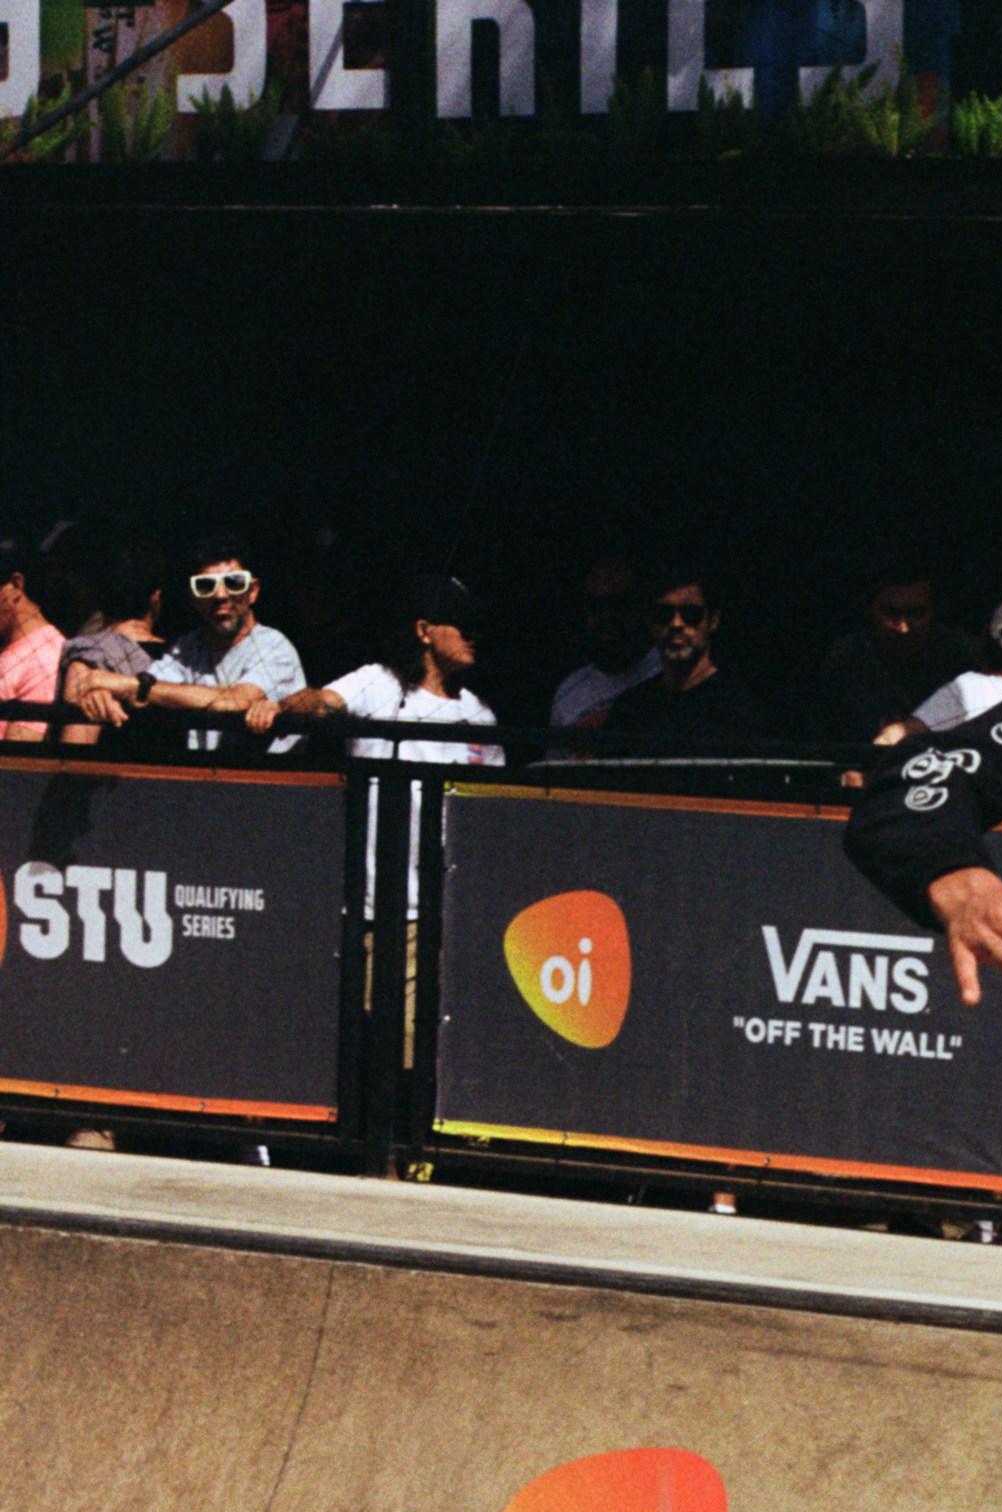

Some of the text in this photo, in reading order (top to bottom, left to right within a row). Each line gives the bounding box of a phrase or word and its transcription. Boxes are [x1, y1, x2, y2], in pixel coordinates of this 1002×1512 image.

[13, 861, 174, 969] STU
[175, 884, 265, 912] QUALIFYING
[182, 914, 236, 940] SERIES
[540, 937, 592, 1005] oi
[762, 925, 935, 1014] VANS
[808, 1022, 865, 1052] THE
